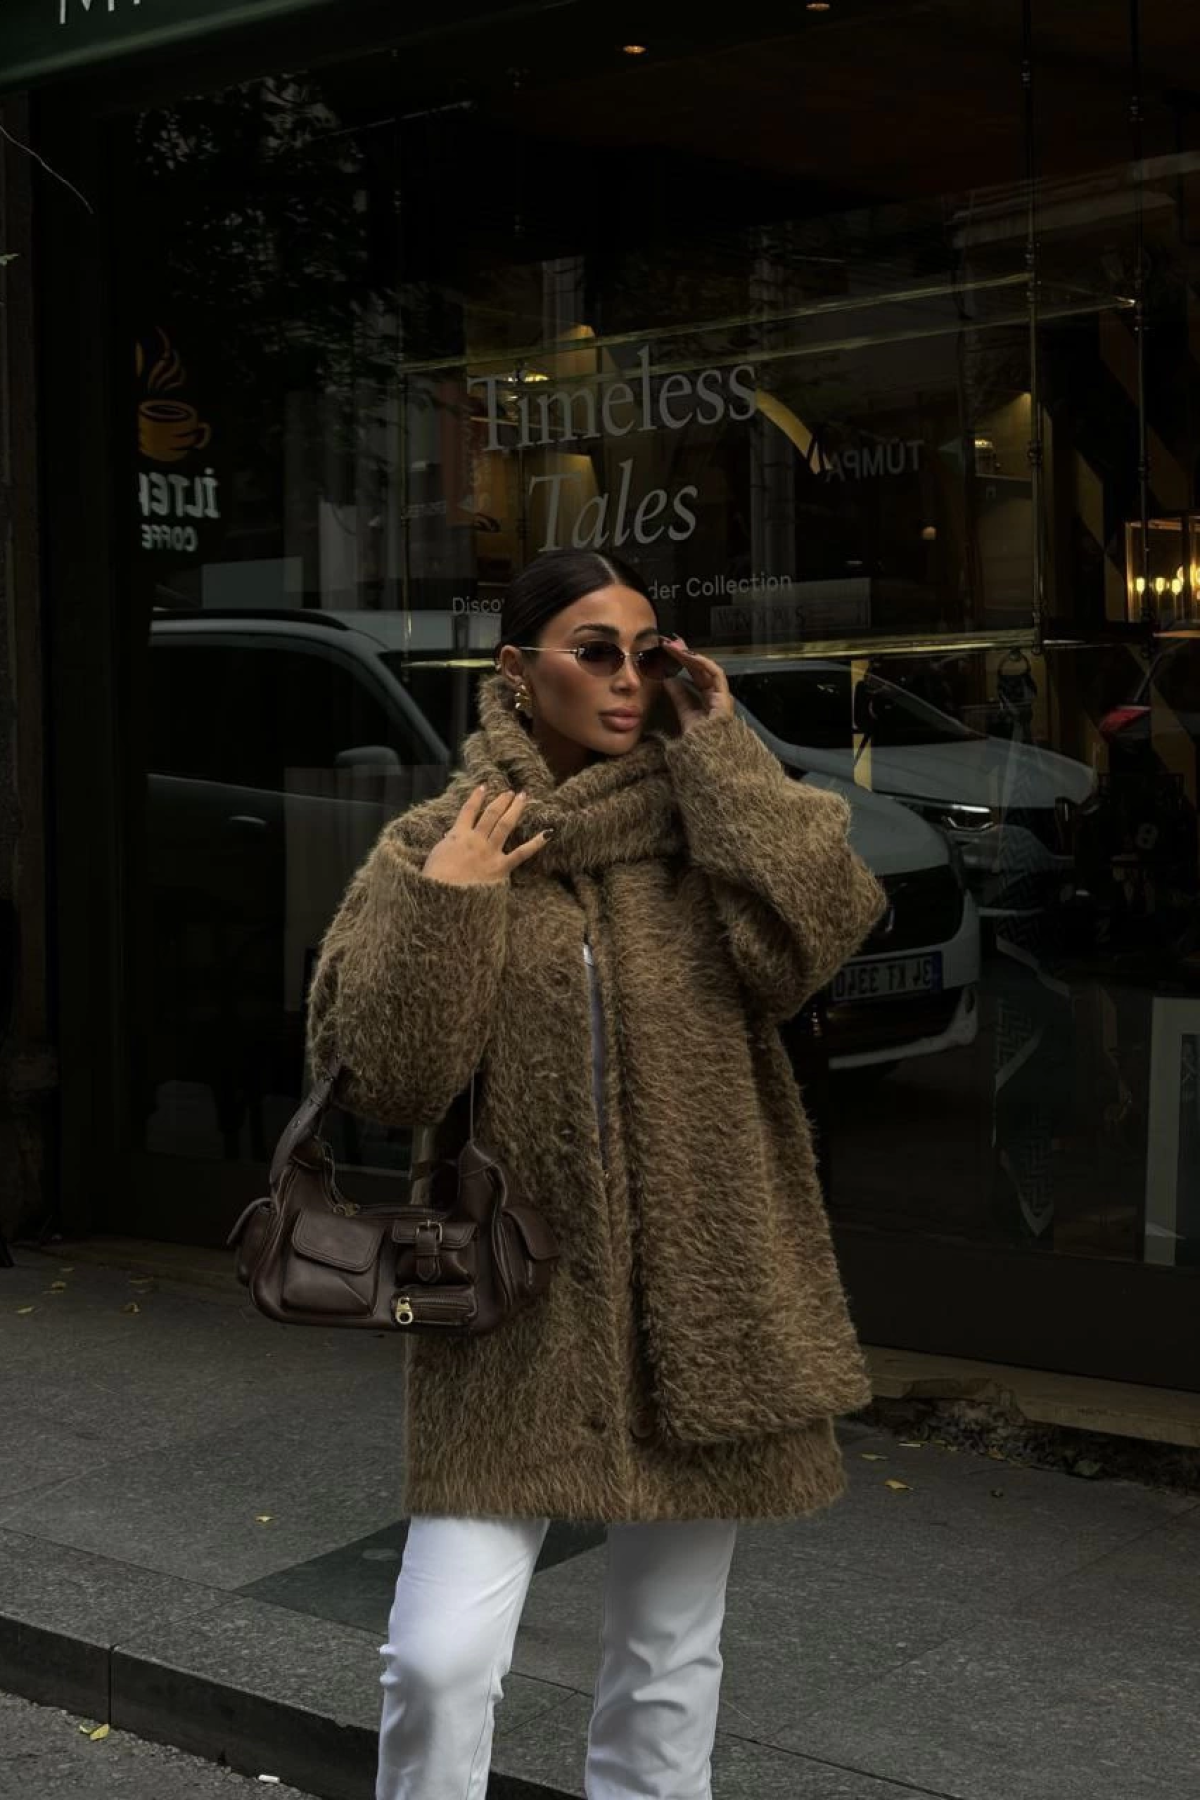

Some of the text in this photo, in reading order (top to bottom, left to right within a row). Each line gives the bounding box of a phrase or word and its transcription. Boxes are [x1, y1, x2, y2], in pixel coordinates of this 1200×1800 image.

[467, 344, 757, 452] Timeless
[528, 457, 699, 552] Tales
[452, 572, 793, 616] Disco der Collection
